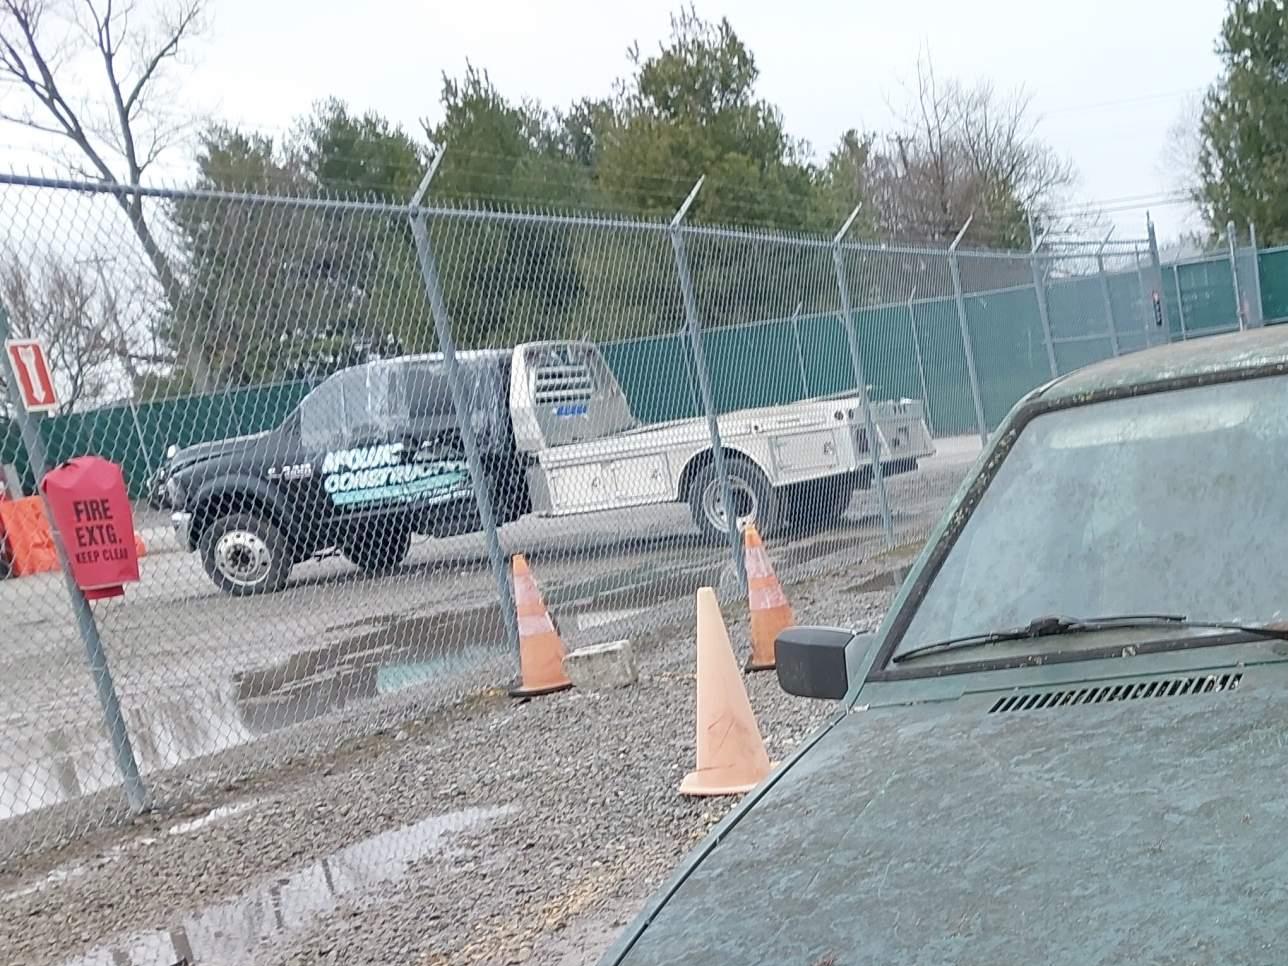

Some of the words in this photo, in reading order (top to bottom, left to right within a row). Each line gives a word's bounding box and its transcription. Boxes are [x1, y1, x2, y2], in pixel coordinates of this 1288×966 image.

[73, 499, 113, 522] FIRE
[75, 523, 122, 547] EXTG.
[75, 550, 100, 564] KEEP
